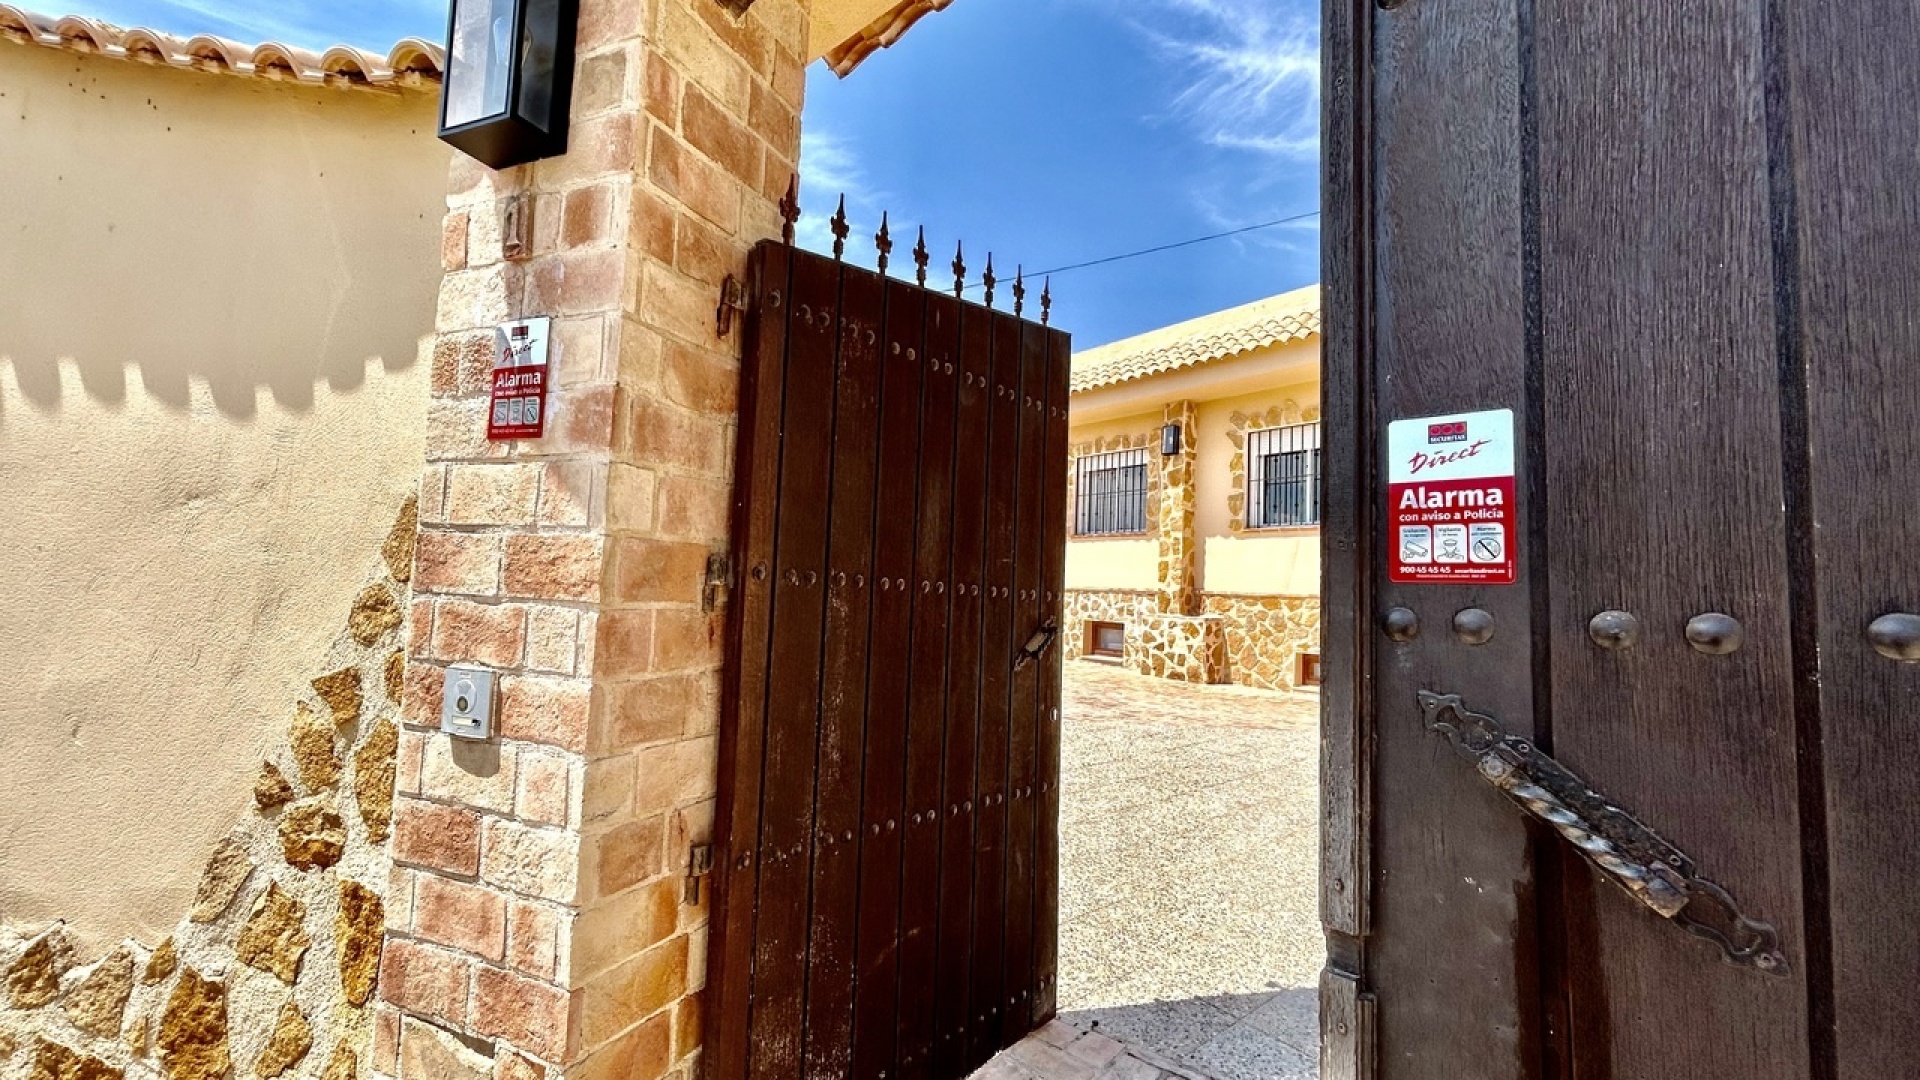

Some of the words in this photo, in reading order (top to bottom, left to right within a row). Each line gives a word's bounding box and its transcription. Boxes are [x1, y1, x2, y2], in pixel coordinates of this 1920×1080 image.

[495, 371, 541, 388] Alarma
[1408, 439, 1493, 475] Direct
[1398, 486, 1504, 510] Alarma
[1399, 513, 1419, 522] con
[1421, 510, 1451, 521] aviso
[1453, 511, 1462, 520] a
[1463, 507, 1504, 520] Policía
[1399, 566, 1415, 574] 900
[1415, 566, 1427, 574] 45
[1427, 566, 1439, 574] 45
[1439, 566, 1451, 574] 45
